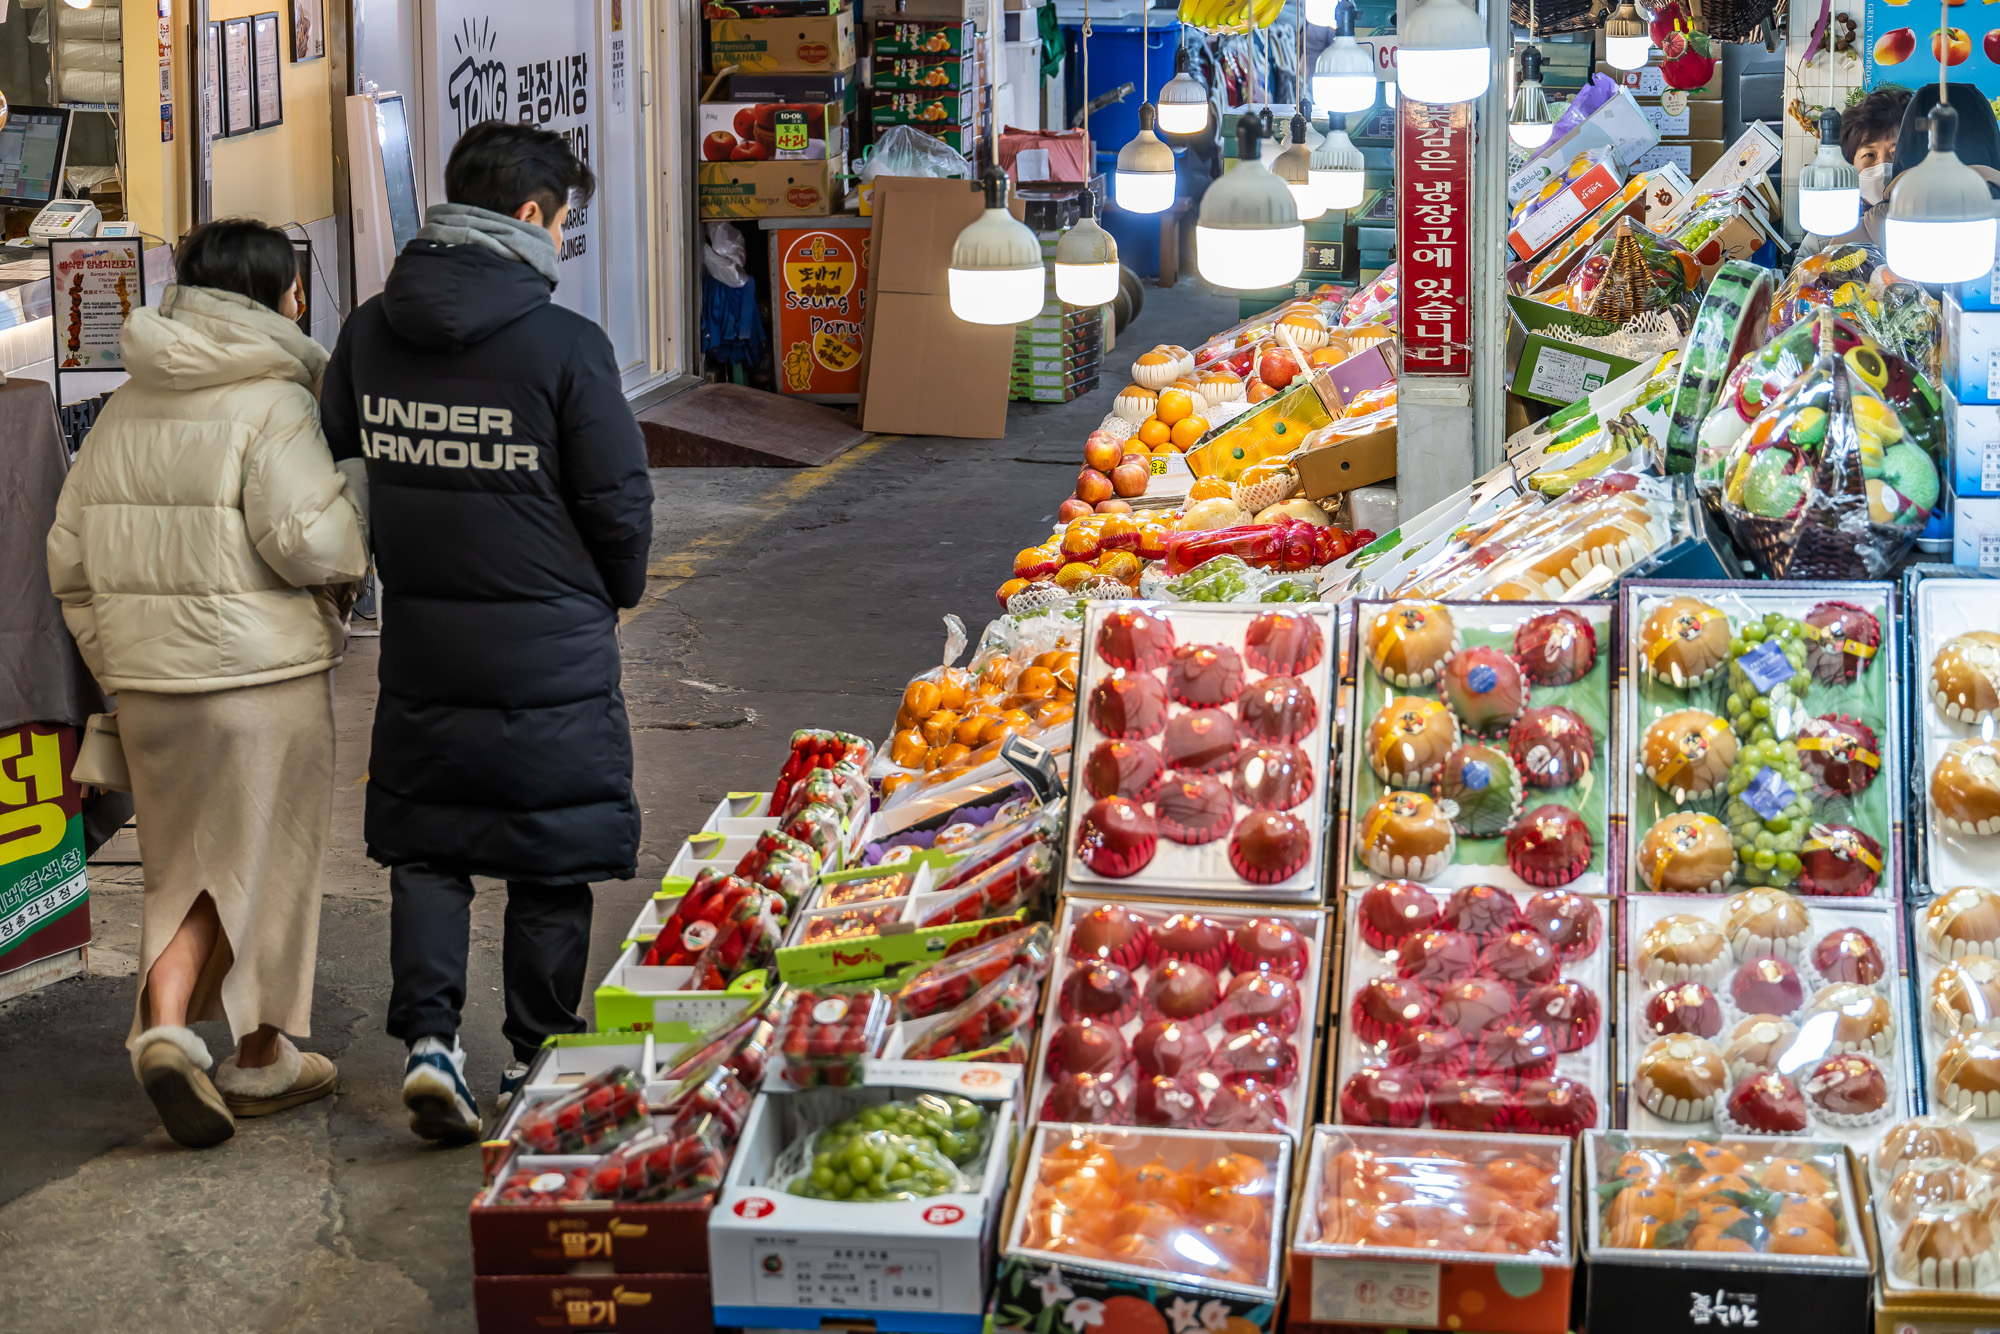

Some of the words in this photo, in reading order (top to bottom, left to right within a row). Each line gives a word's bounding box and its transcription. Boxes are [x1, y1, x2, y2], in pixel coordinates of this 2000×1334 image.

[714, 43, 755, 51] Premium
[1865, 33, 1873, 84] TOMORROW
[517, 52, 587, 125] 광장시장
[777, 134, 806, 148] 사과
[702, 186, 744, 194] Premium
[1412, 181, 1458, 268] 냉장고에
[561, 233, 587, 262] OJINGEO
[60, 261, 85, 270] 바삭한
[86, 260, 136, 270] 양념치킨꼬치
[786, 291, 849, 315] Seung
[1413, 278, 1457, 366] 있습니다
[363, 394, 513, 436] UNDER
[0, 848, 81, 914] 버검색창
[562, 1231, 613, 1257] 딸기
[566, 1300, 617, 1325] 딸기
